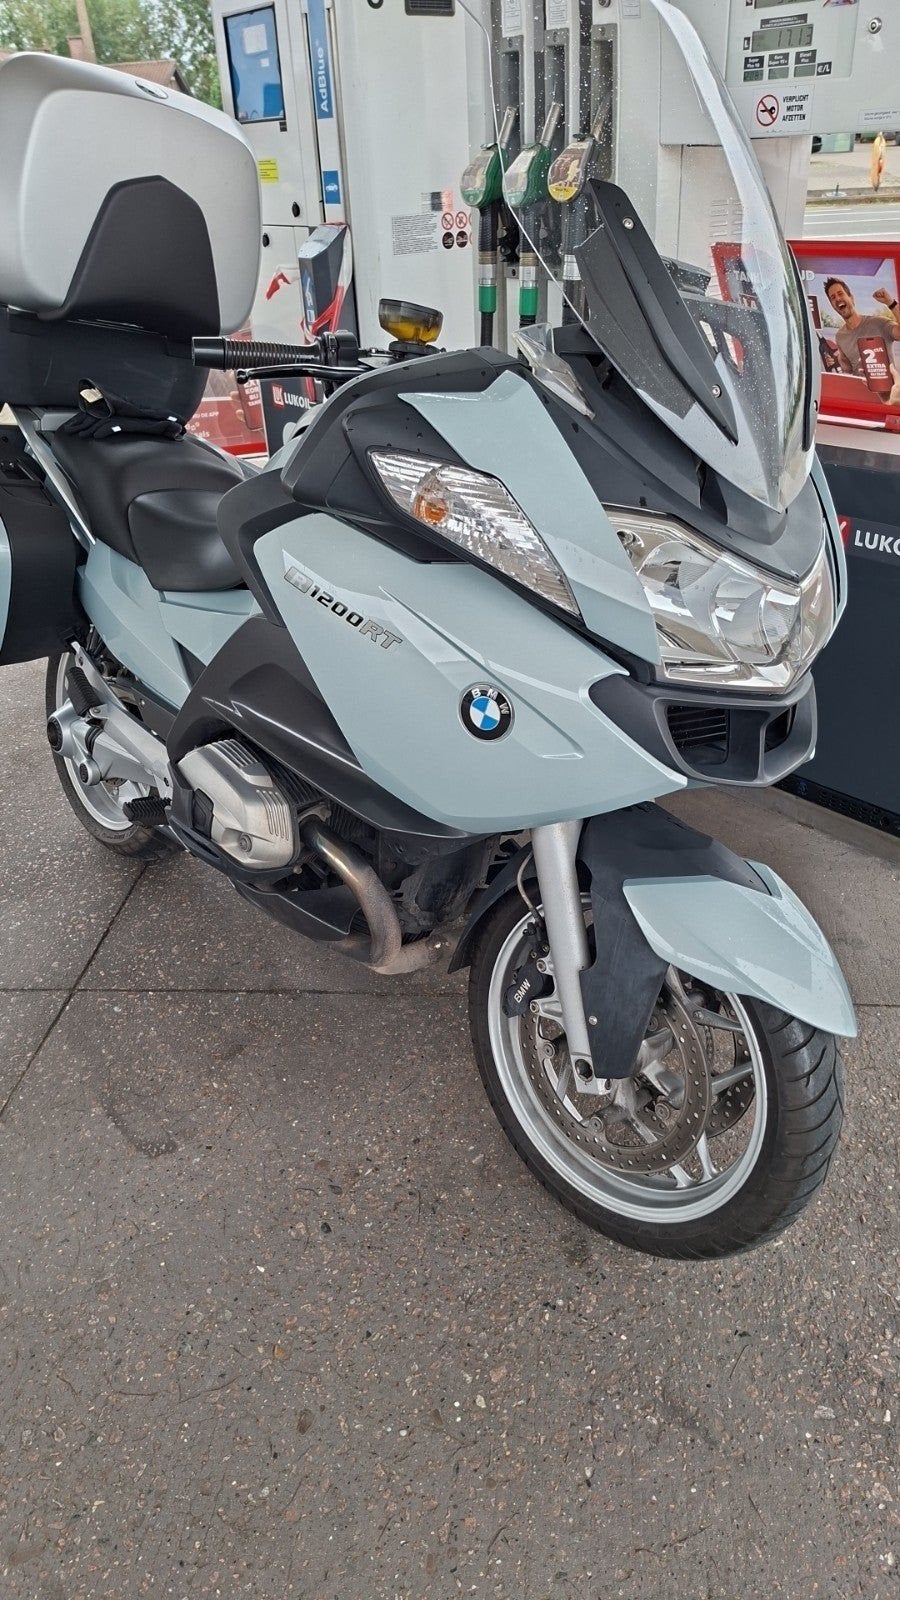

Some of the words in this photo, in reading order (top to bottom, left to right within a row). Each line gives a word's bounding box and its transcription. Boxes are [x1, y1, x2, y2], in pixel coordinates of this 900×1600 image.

[318, 47, 329, 113] AdBlue
[782, 94, 810, 103] VERPLICHT
[786, 104, 804, 112] MOTOR
[781, 113, 807, 122] AFZETTEN
[862, 349, 878, 364] 2
[471, 688, 510, 715] BMW
[513, 978, 531, 1004] BMW
